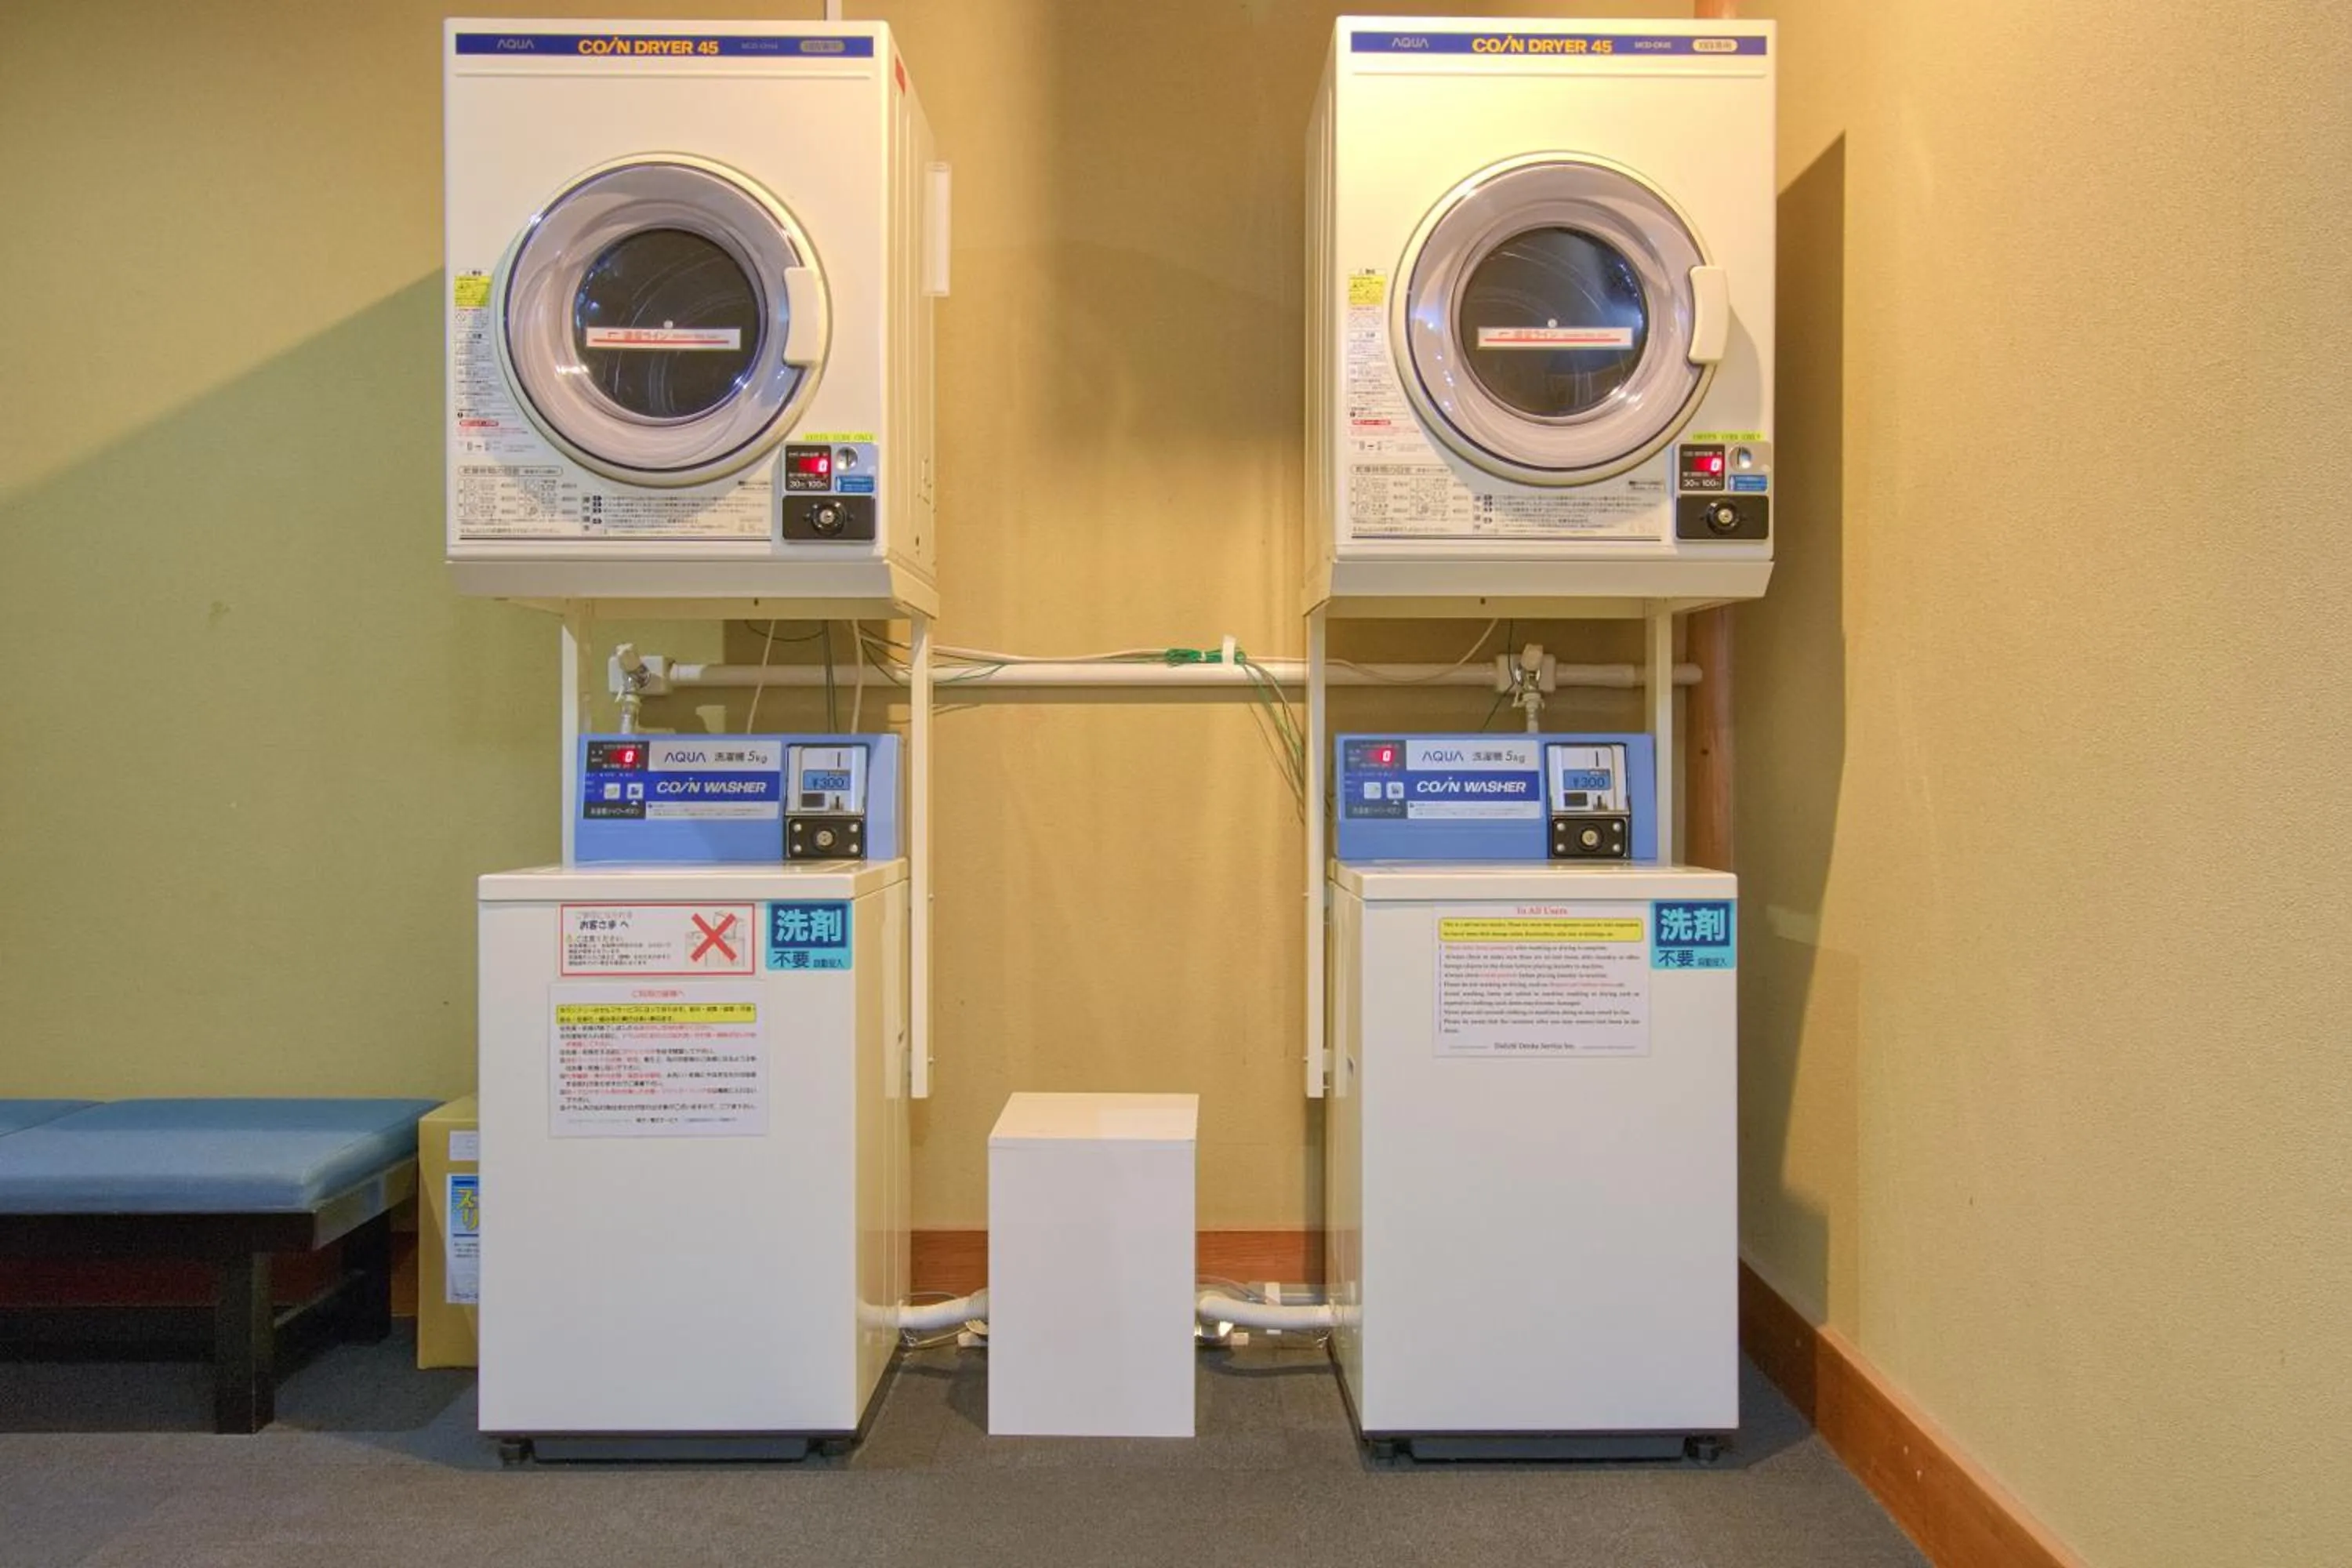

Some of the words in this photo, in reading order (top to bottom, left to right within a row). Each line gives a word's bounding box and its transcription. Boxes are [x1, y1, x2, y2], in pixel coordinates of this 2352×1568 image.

[496, 38, 535, 50] AQUA
[577, 34, 630, 54] COIN
[633, 39, 695, 55] DRYER
[697, 40, 719, 55] 45
[1392, 37, 1429, 49] AQUA
[1472, 33, 1525, 53] COIN
[1528, 38, 1588, 53] DRYER
[1591, 38, 1613, 54] 45
[818, 458, 828, 473] 0
[1710, 457, 1722, 472] 0
[625, 750, 633, 763] 0
[665, 752, 706, 763] AQUA
[714, 751, 745, 763] 洗濯機
[747, 750, 768, 764] 5kg
[1382, 750, 1391, 762] 0
[1421, 750, 1464, 762] AQUA
[656, 777, 701, 794] COIN
[704, 781, 767, 794] WASHER
[1417, 776, 1461, 793] COIN
[1464, 780, 1526, 793] WASHER
[777, 908, 842, 942] 洗剤
[1660, 907, 1726, 942] 洗剤
[773, 950, 810, 969] 不要
[1658, 949, 1694, 967] 不要
